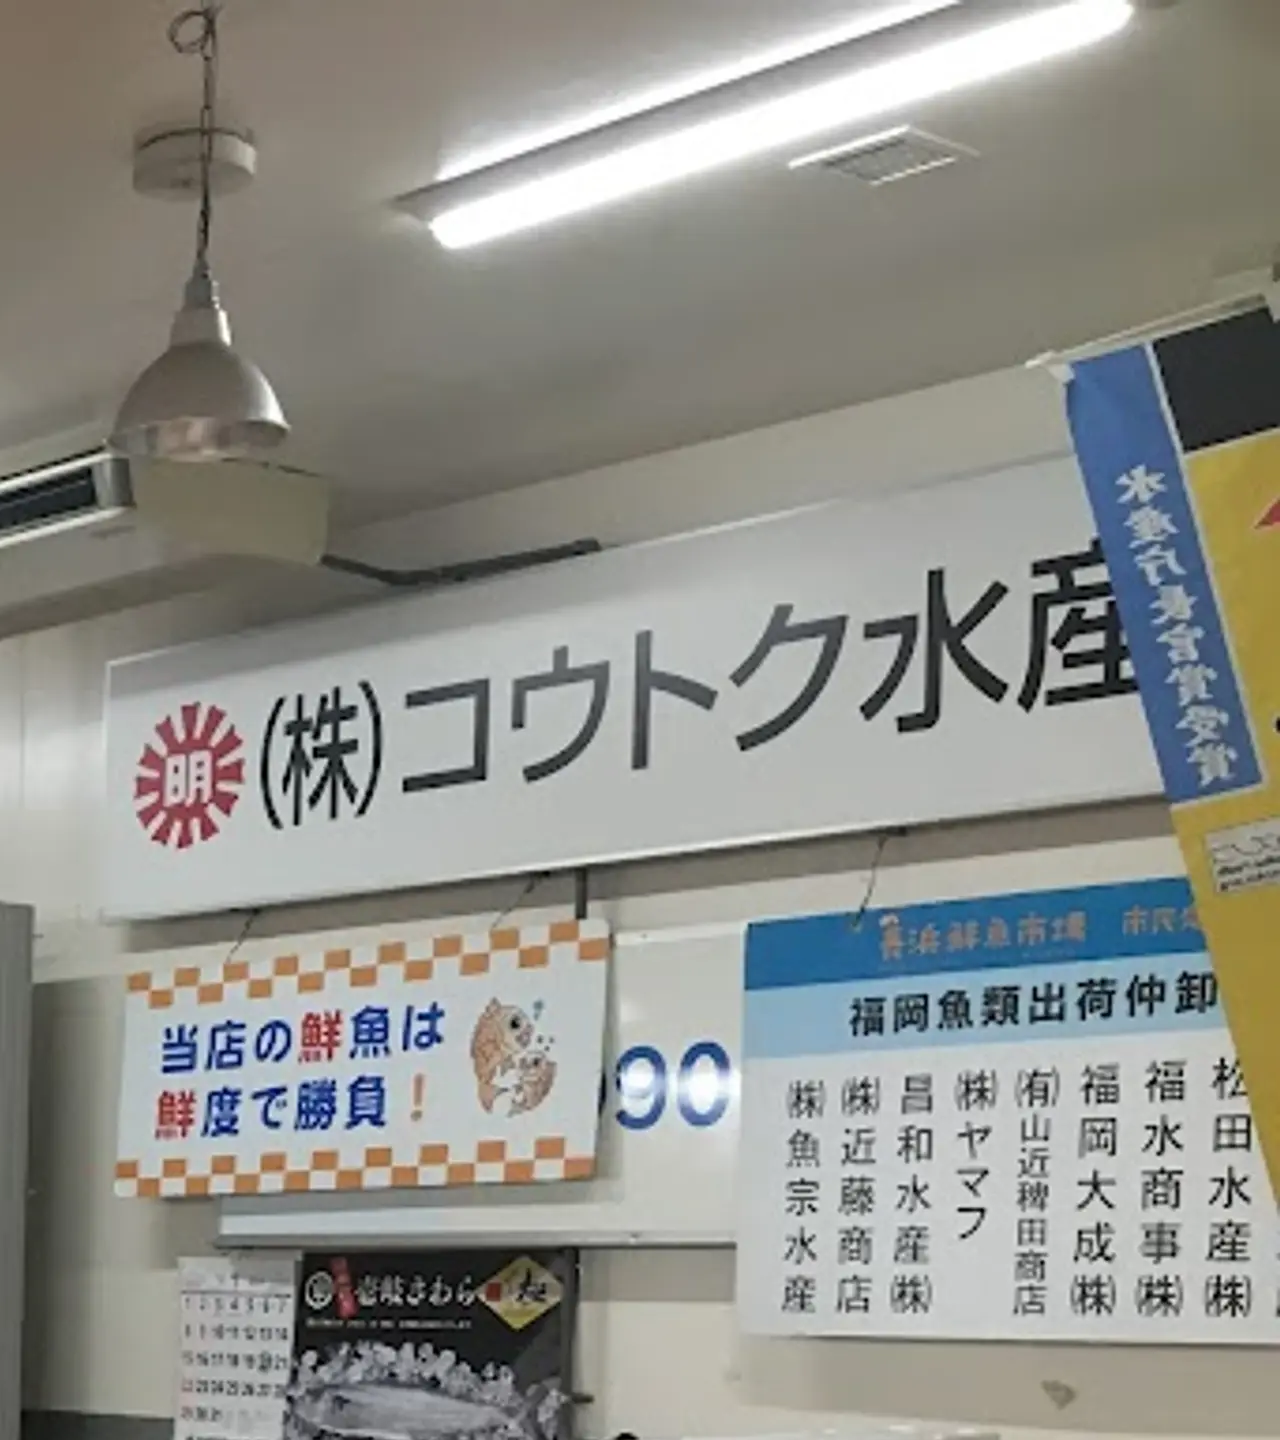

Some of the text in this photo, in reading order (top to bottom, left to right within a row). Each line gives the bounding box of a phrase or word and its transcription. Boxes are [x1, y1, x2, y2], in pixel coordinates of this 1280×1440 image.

[259, 537, 1142, 832] (株)コウトク水産
[160, 1002, 446, 1075] 当店の鮮魚は
[849, 970, 1218, 1037] 福岡魚類出荷仲卸
[599, 1041, 731, 1130] 90
